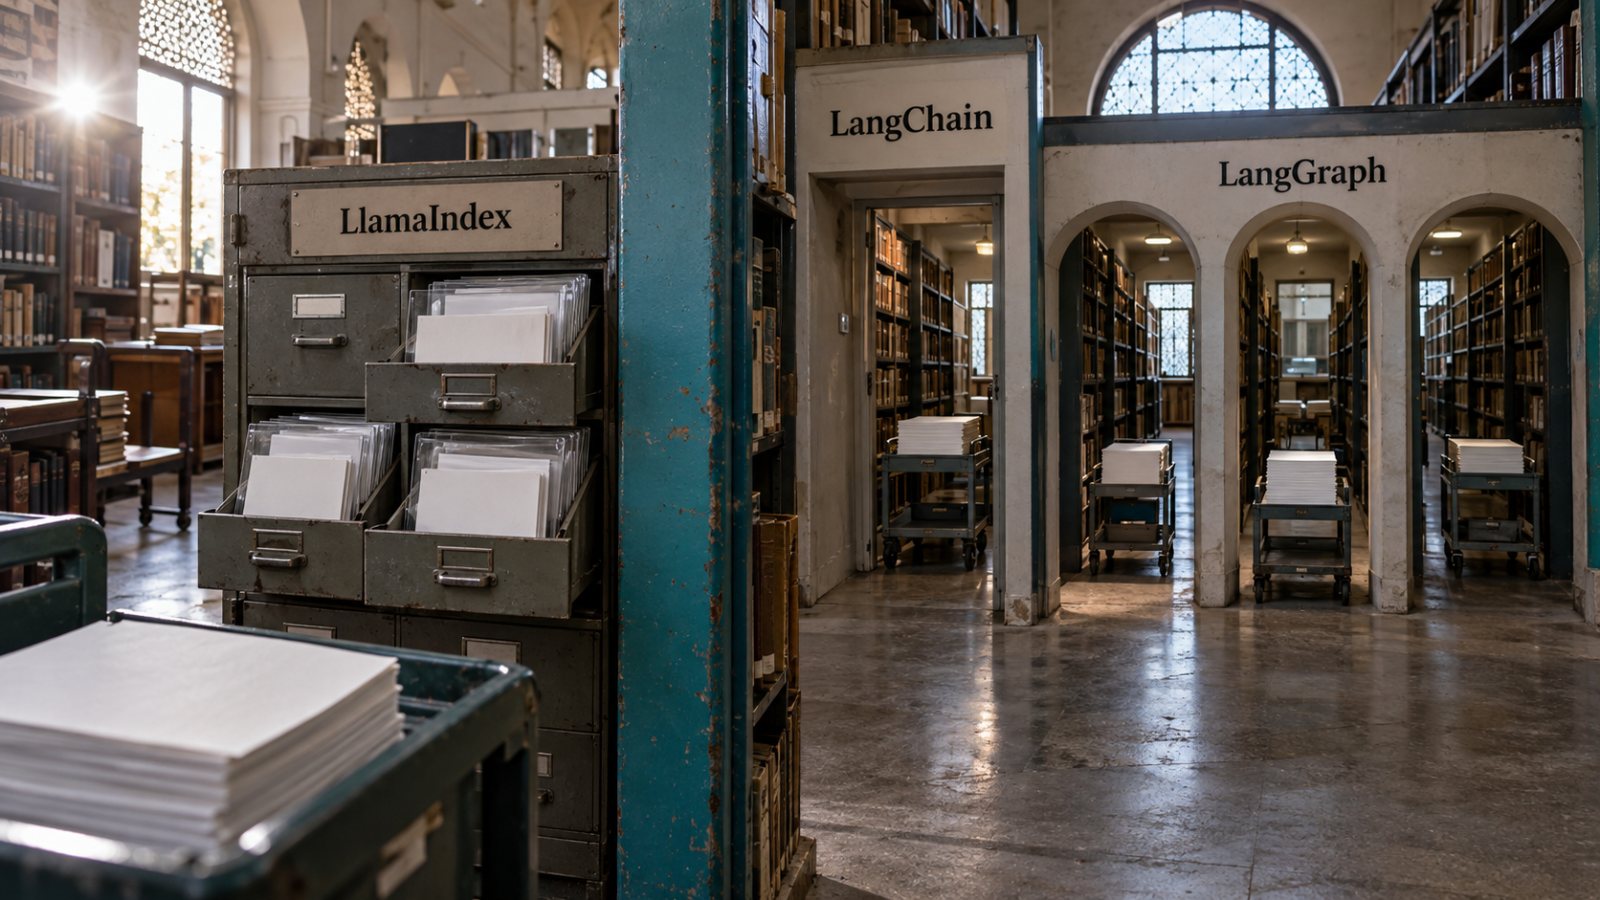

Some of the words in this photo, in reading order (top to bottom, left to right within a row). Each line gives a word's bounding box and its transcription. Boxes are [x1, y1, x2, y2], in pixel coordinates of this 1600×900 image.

[829, 103, 994, 143] LangChain
[1218, 156, 1388, 194] LangGraph
[339, 201, 513, 235] LlamaIndex
